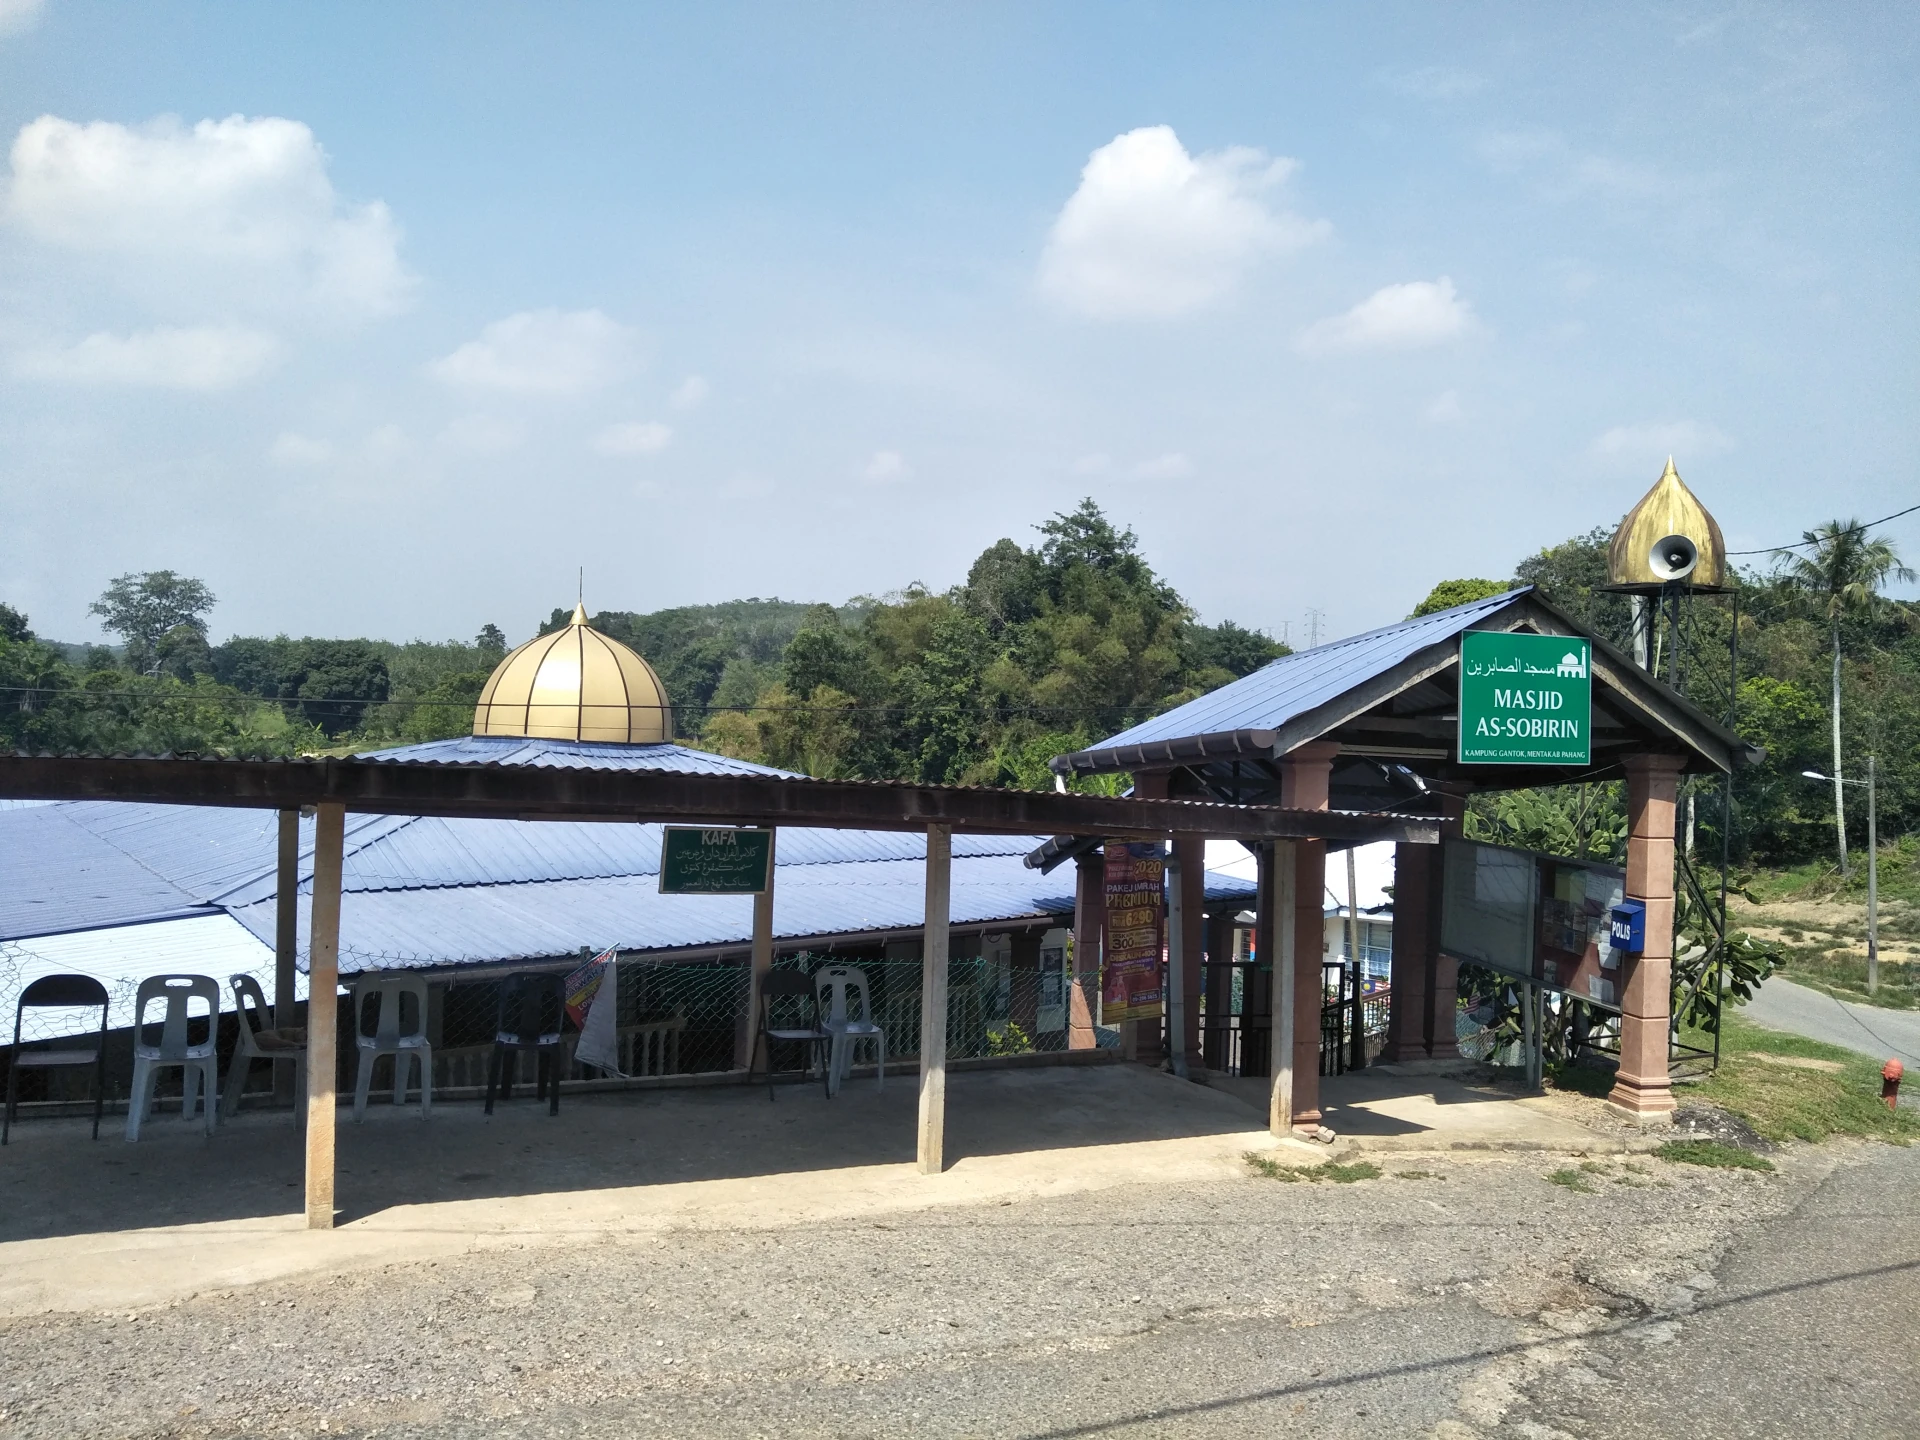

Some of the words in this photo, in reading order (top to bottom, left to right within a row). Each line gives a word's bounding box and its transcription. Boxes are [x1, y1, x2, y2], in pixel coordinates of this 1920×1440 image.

[1466, 656, 1522, 677] الصابرين
[1523, 662, 1556, 677] مسجد
[1493, 688, 1563, 711] MASJID
[1475, 716, 1578, 739] AS-SOBIRIN
[1464, 749, 1498, 757] KAMPUNG
[1527, 750, 1560, 758] MENTAKAB
[1561, 751, 1586, 759] PAHANG
[701, 830, 737, 846] KAFA
[1106, 884, 1133, 893] PAKEJ
[1611, 920, 1631, 941] POLIS
[1112, 936, 1134, 949] 300
